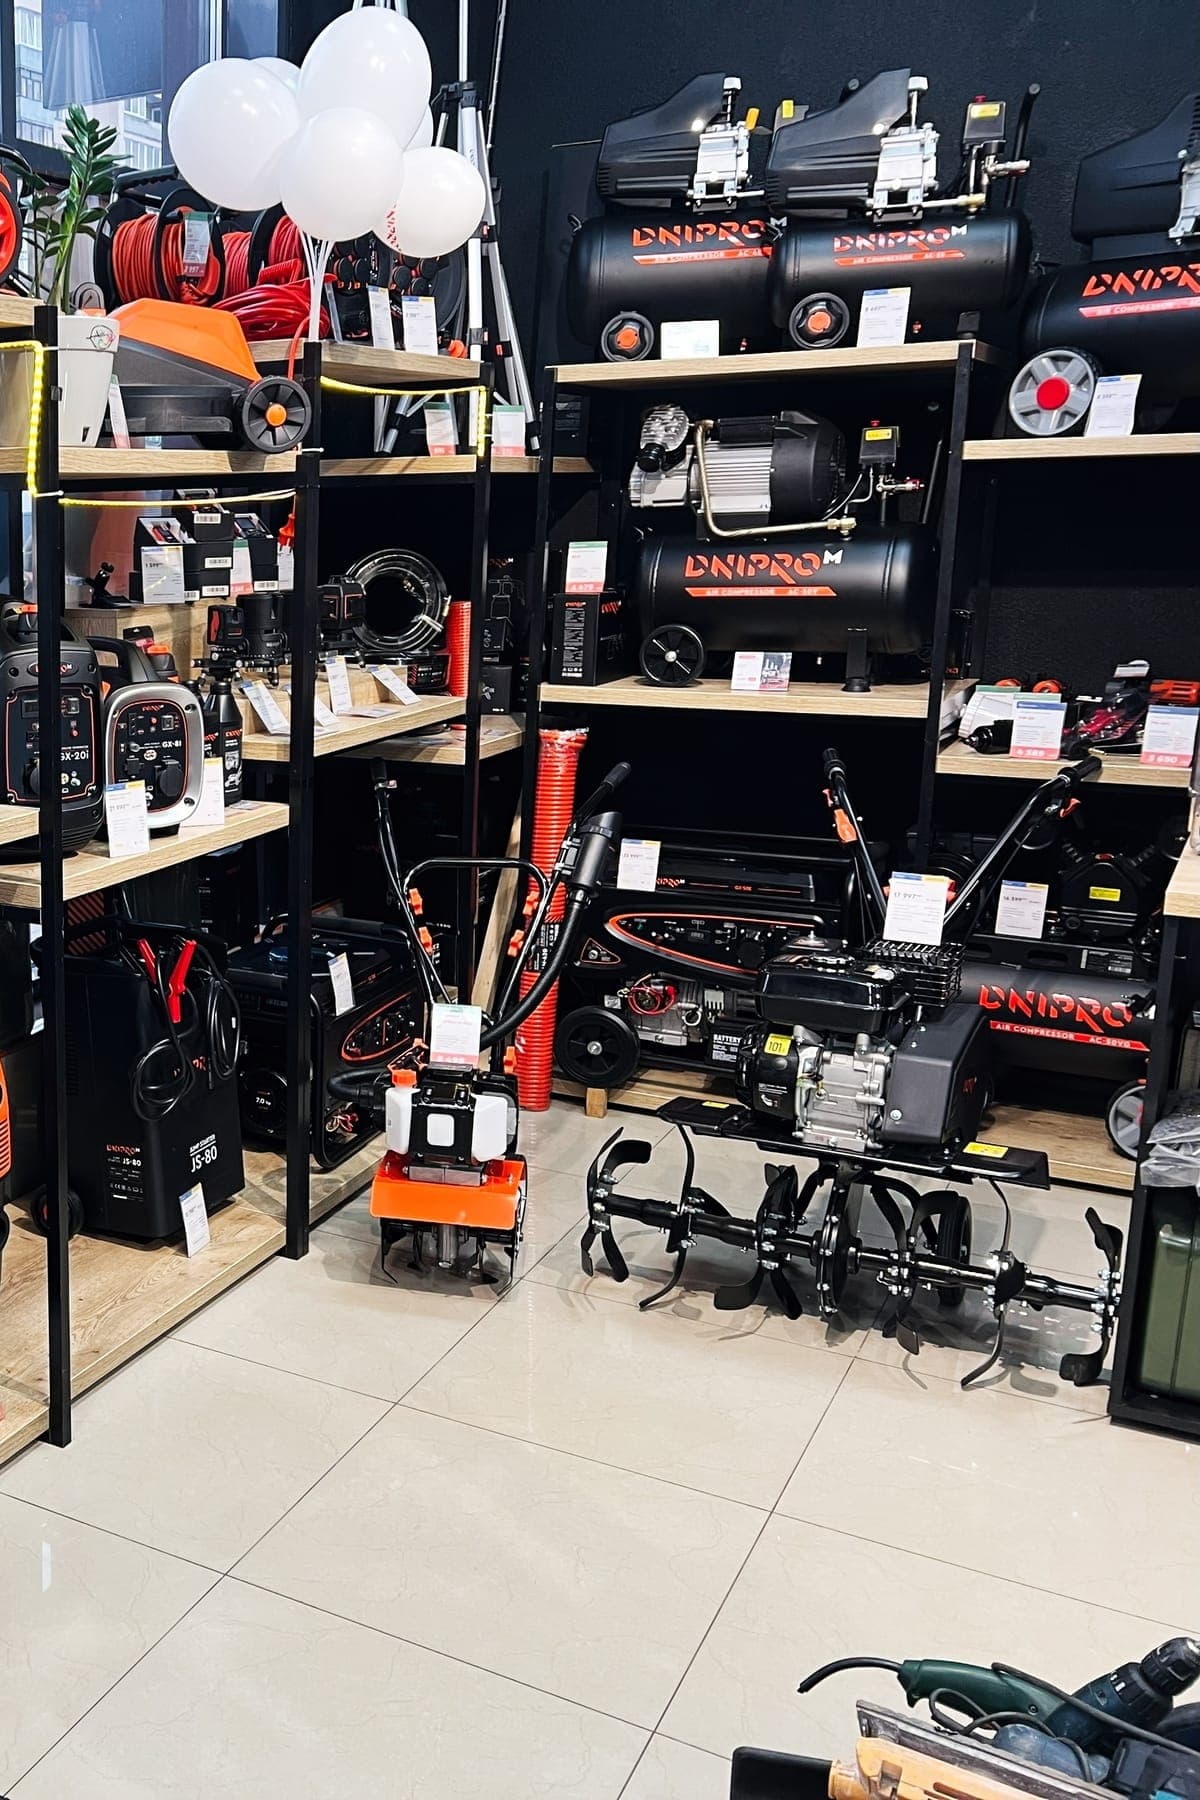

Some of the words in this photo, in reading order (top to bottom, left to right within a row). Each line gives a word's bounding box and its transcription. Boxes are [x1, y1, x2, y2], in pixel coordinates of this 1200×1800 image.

[632, 219, 767, 247] DNIPRO
[833, 228, 951, 252] DNIPRO
[685, 553, 821, 585] DNIPRO
[979, 984, 1133, 1034] DNIPRO
[713, 1033, 742, 1044] BATTERY
[995, 1023, 1011, 1032] AIR
[1013, 1025, 1075, 1041] COMPRESSOR
[191, 1145, 218, 1173] JS-80
